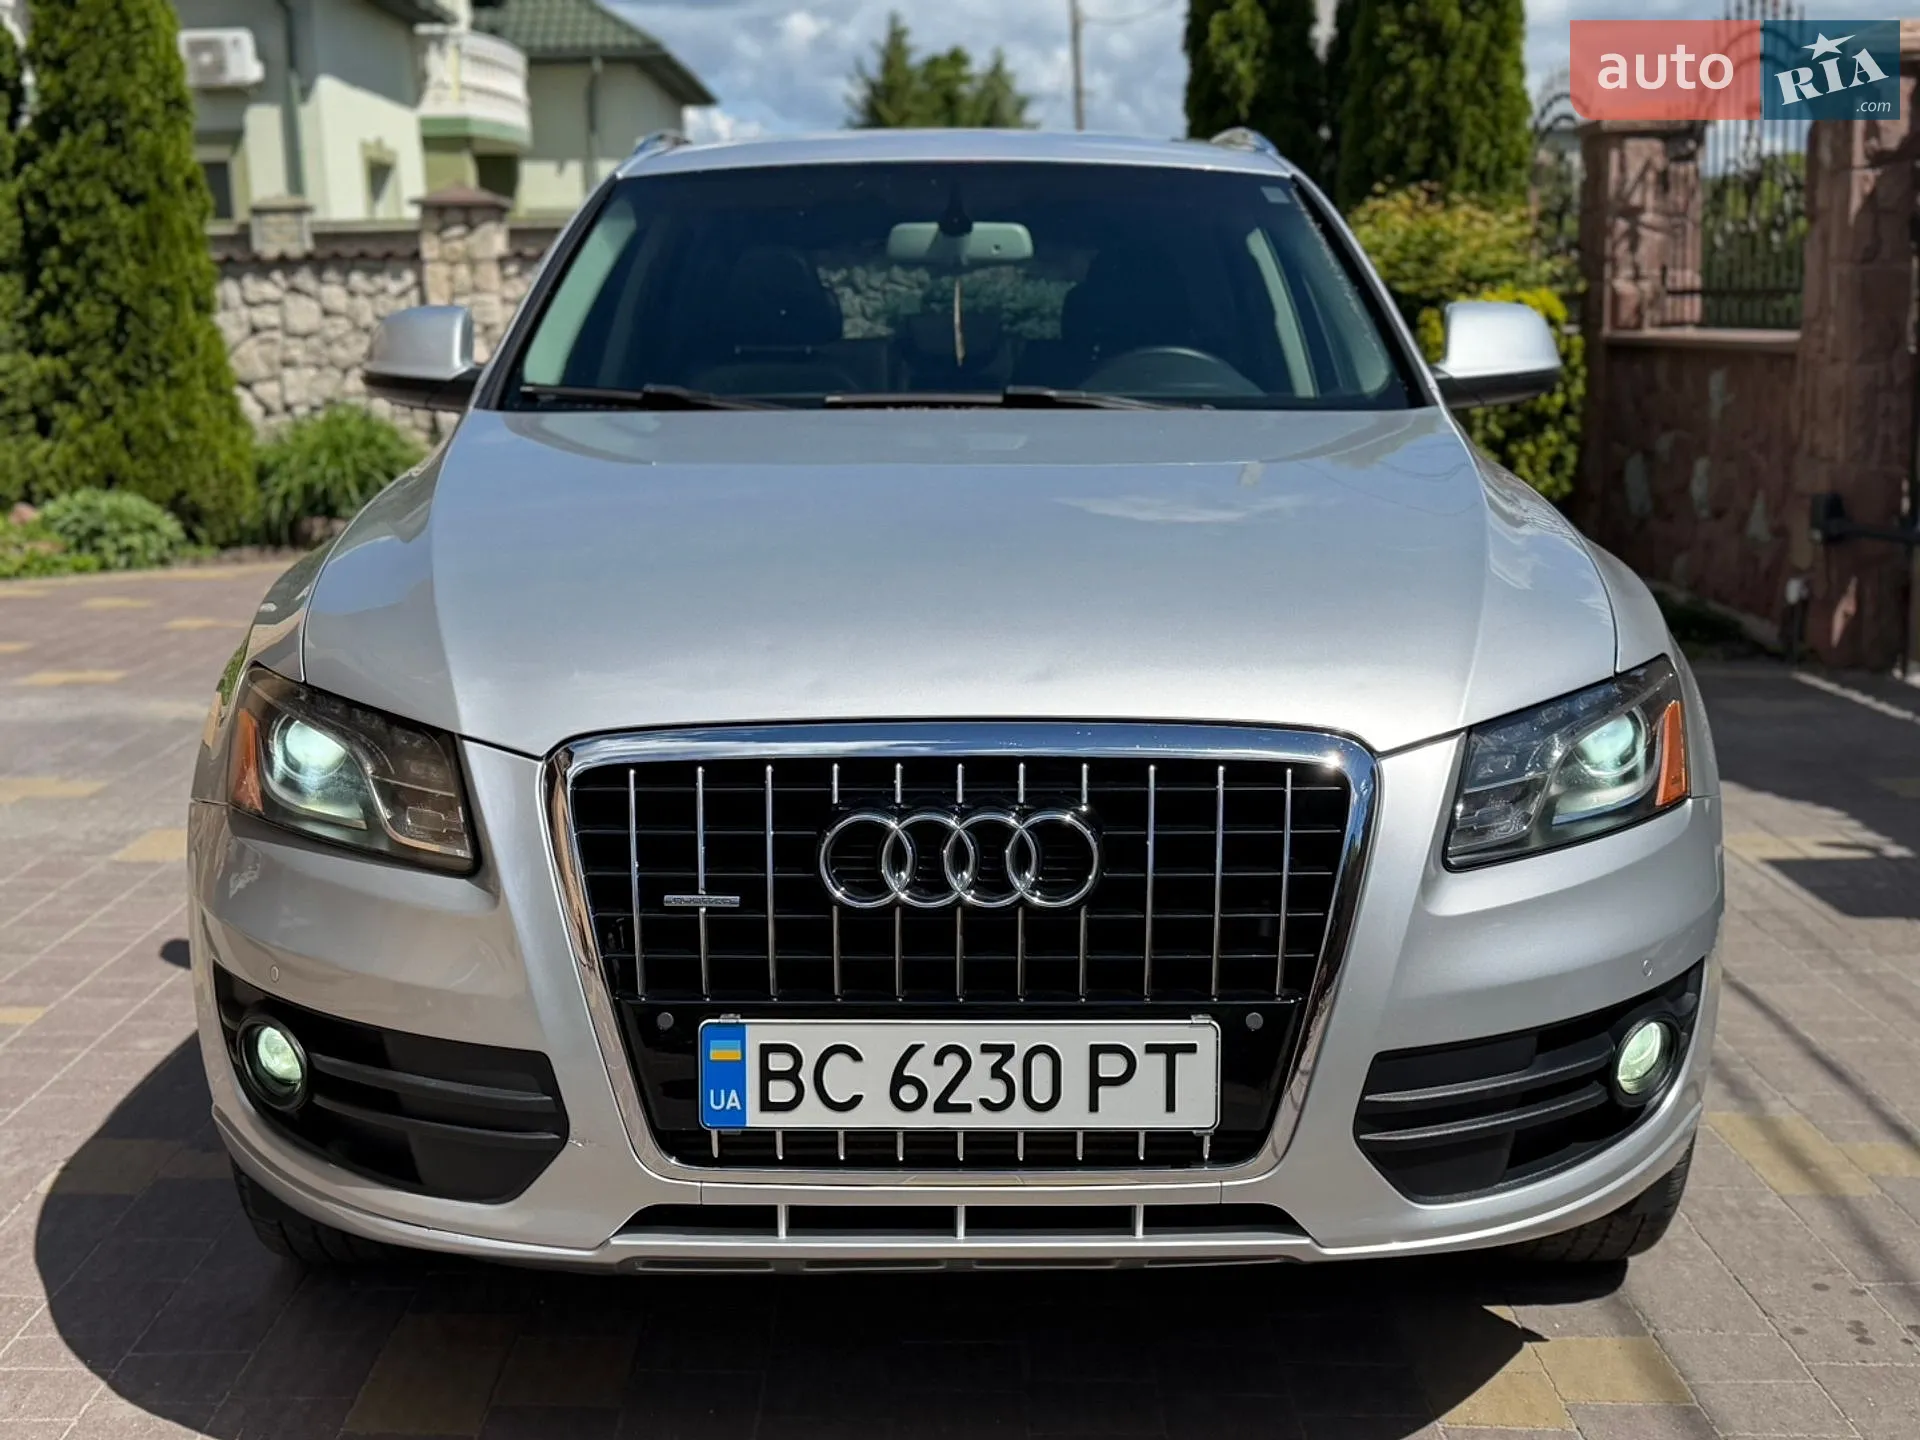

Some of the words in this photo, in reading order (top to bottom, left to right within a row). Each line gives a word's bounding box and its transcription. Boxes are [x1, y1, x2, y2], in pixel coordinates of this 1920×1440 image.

[710, 1089, 741, 1110] UA
[759, 1043, 864, 1112] BC
[889, 1043, 1062, 1113] 6230
[1089, 1043, 1198, 1112] PT
